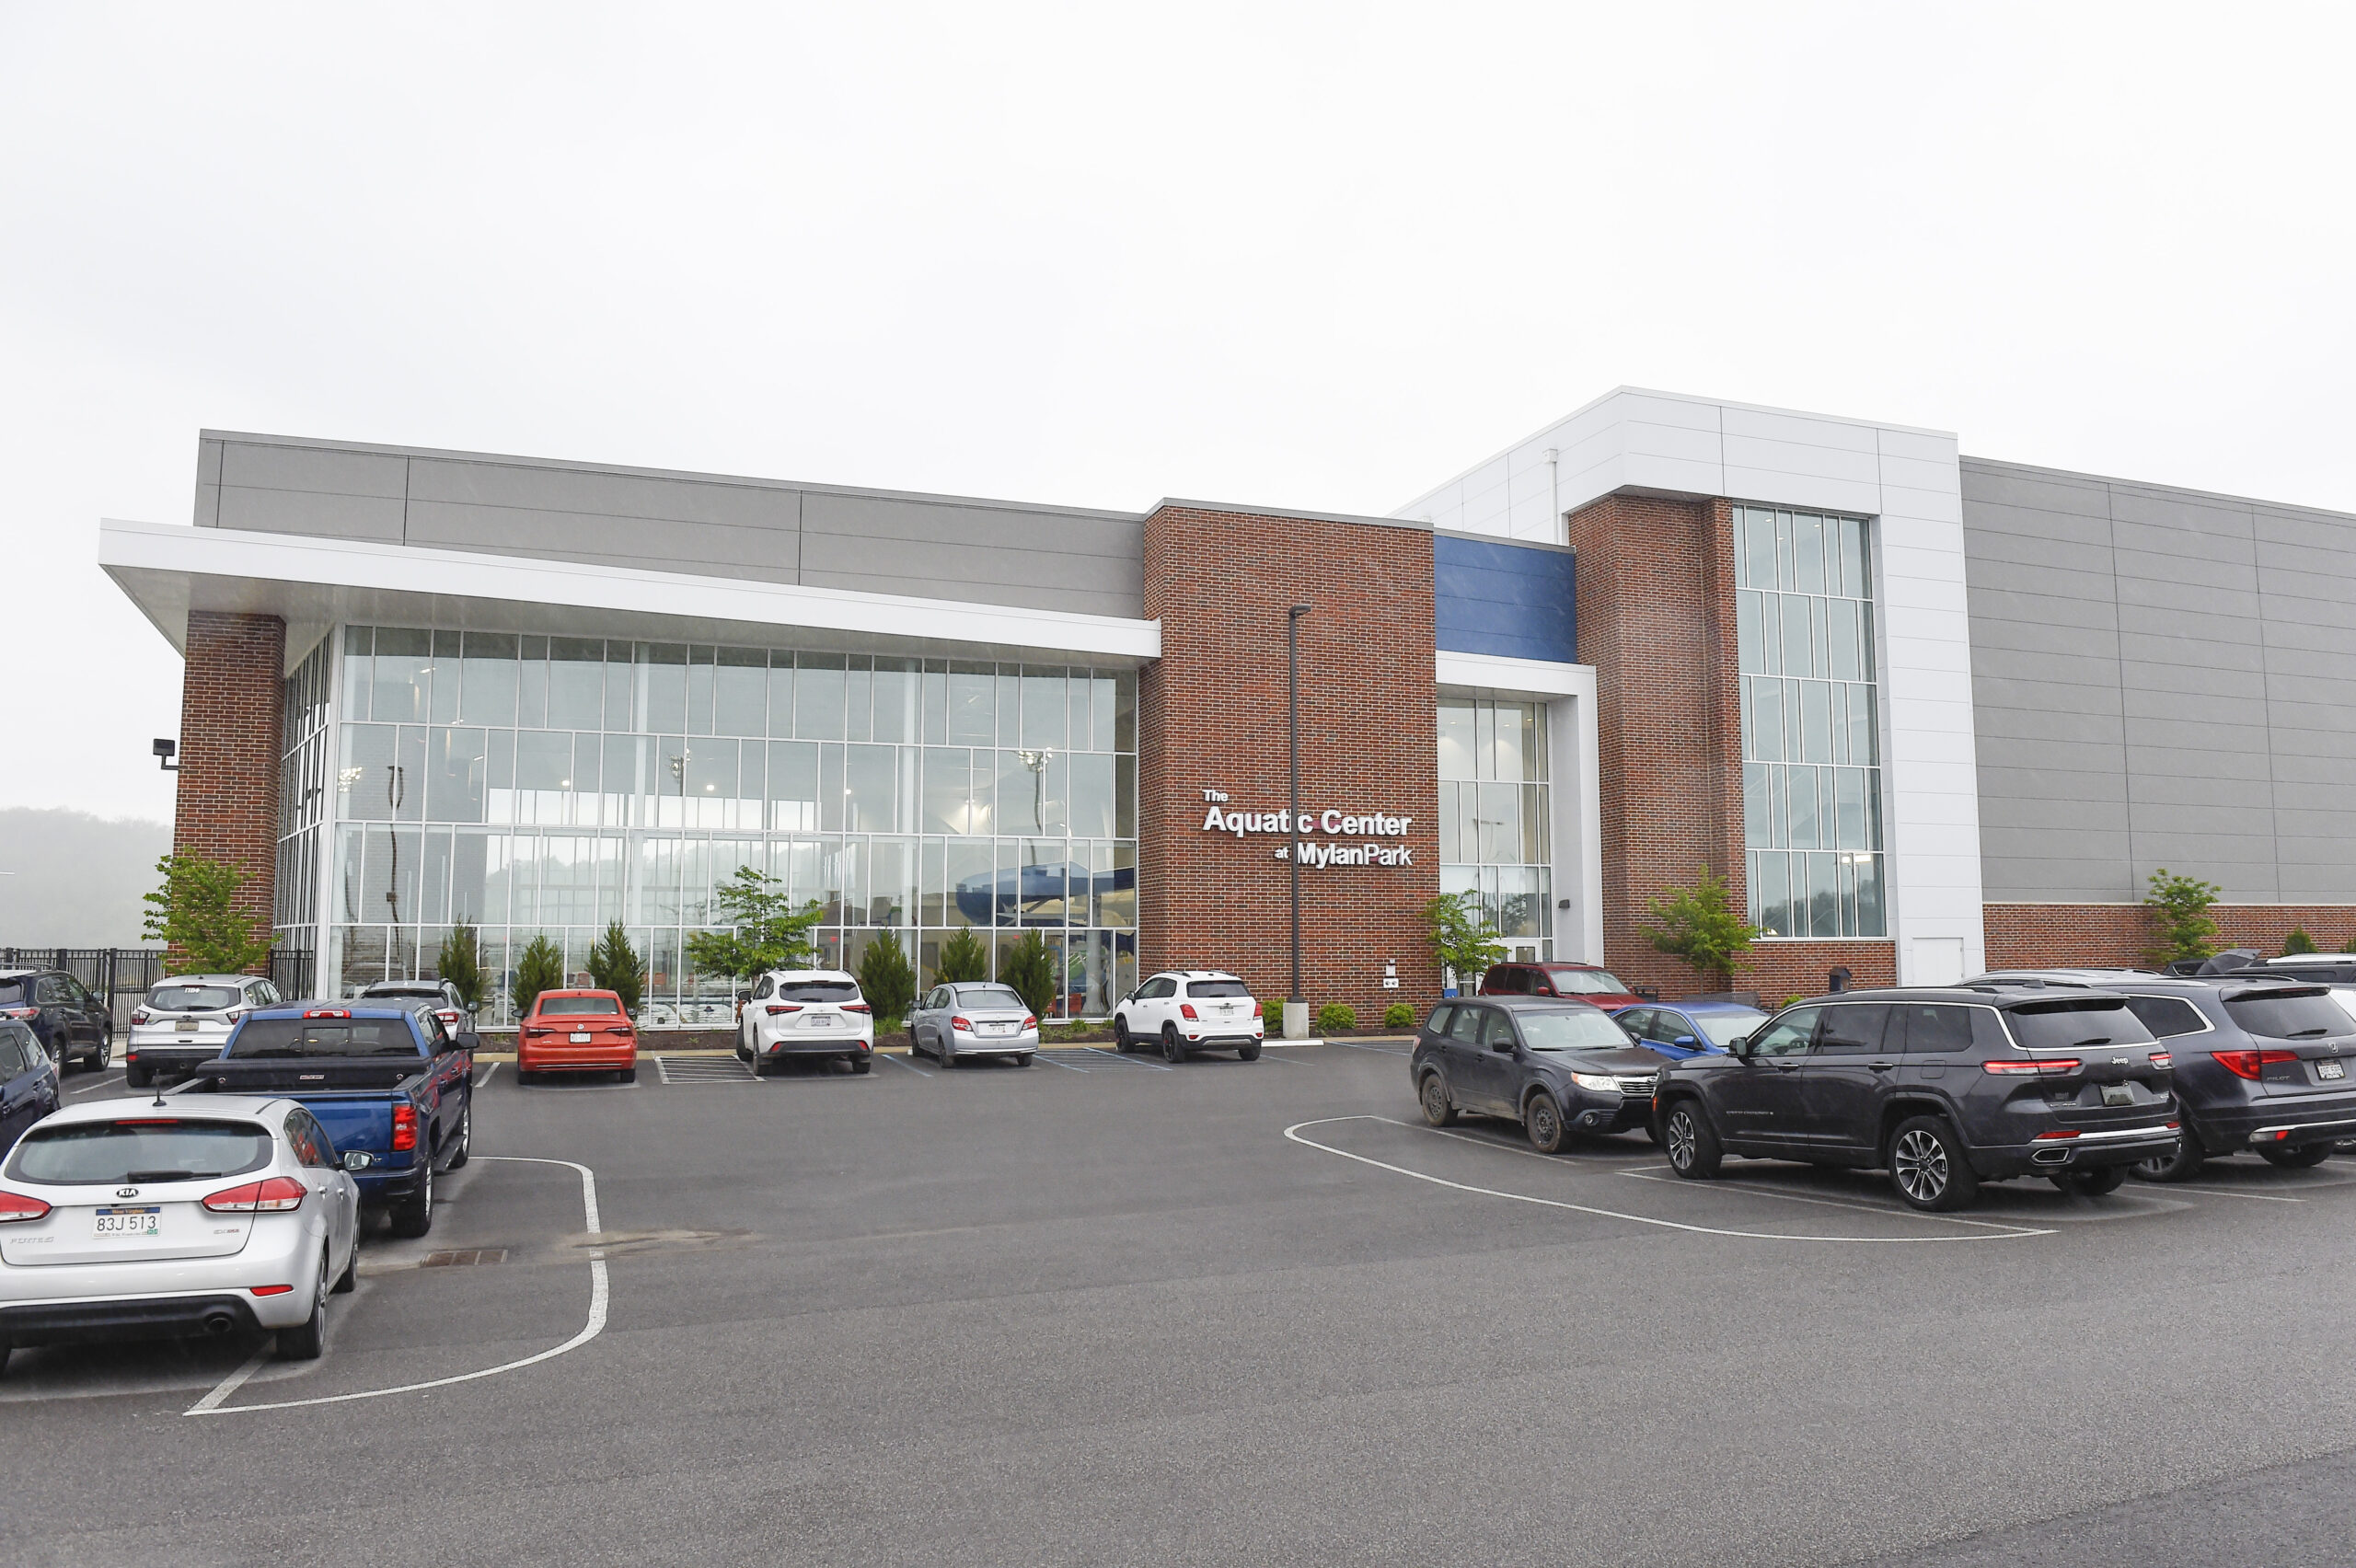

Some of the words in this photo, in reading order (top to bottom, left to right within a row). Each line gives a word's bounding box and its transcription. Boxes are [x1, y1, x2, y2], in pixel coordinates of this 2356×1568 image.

[1202, 790, 1230, 802] The
[1202, 806, 1313, 837] Aquatc
[1321, 810, 1413, 836] Center
[1274, 847, 1289, 859] at
[2111, 1056, 2129, 1065] Jeep
[97, 1217, 124, 1231] 83J
[129, 1216, 156, 1230] 513
